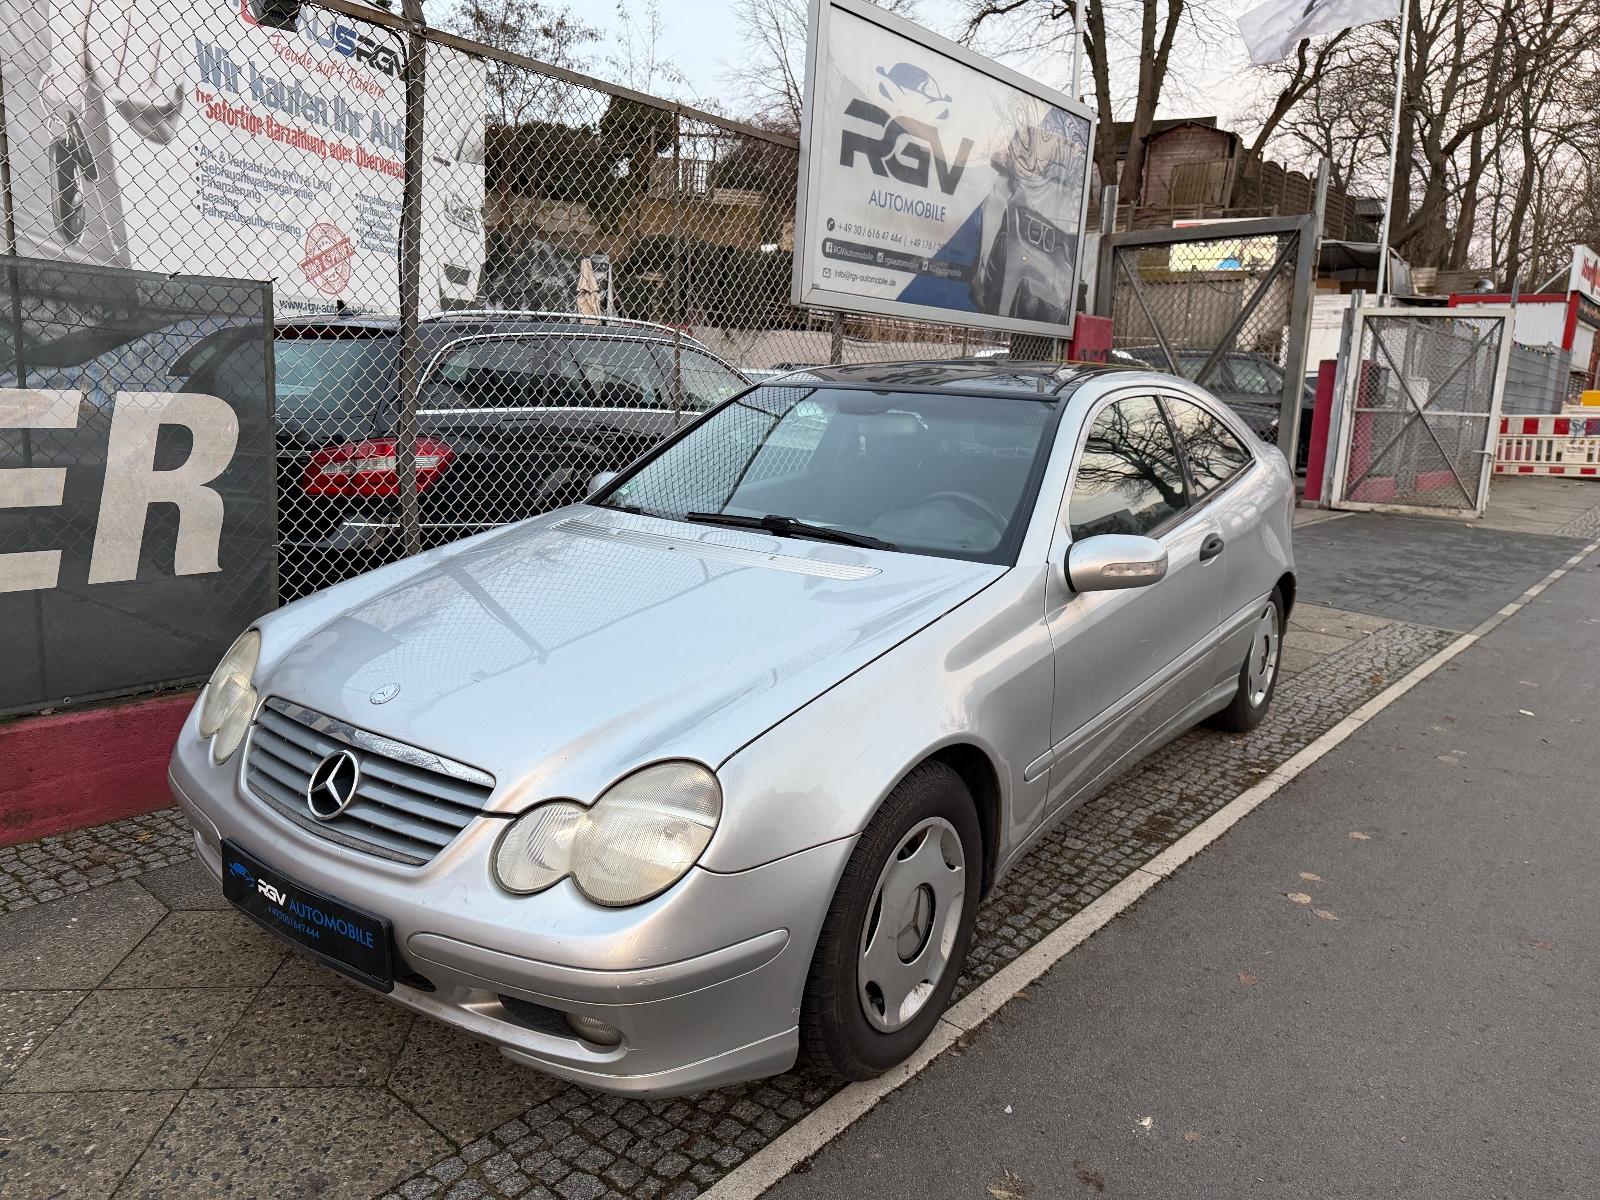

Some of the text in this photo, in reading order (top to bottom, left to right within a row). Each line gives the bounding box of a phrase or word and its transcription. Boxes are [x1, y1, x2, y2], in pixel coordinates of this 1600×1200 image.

[270, 33, 313, 69] Freude
[315, 58, 338, 79] auf
[195, 38, 405, 152] Wir kaufen Ihr Aut
[206, 97, 405, 180] Sofortige Barzahlung oder Überweisu
[839, 98, 975, 196] RGV
[201, 173, 262, 203] Finanzierung
[202, 191, 239, 212] Leasing
[868, 189, 947, 223] AUTOMOBILE
[202, 202, 301, 238] Fahrzeugaufbereitung
[853, 225, 862, 235] 30
[867, 227, 880, 239] 616
[257, 878, 374, 949] RGV AUTOMOBILE
